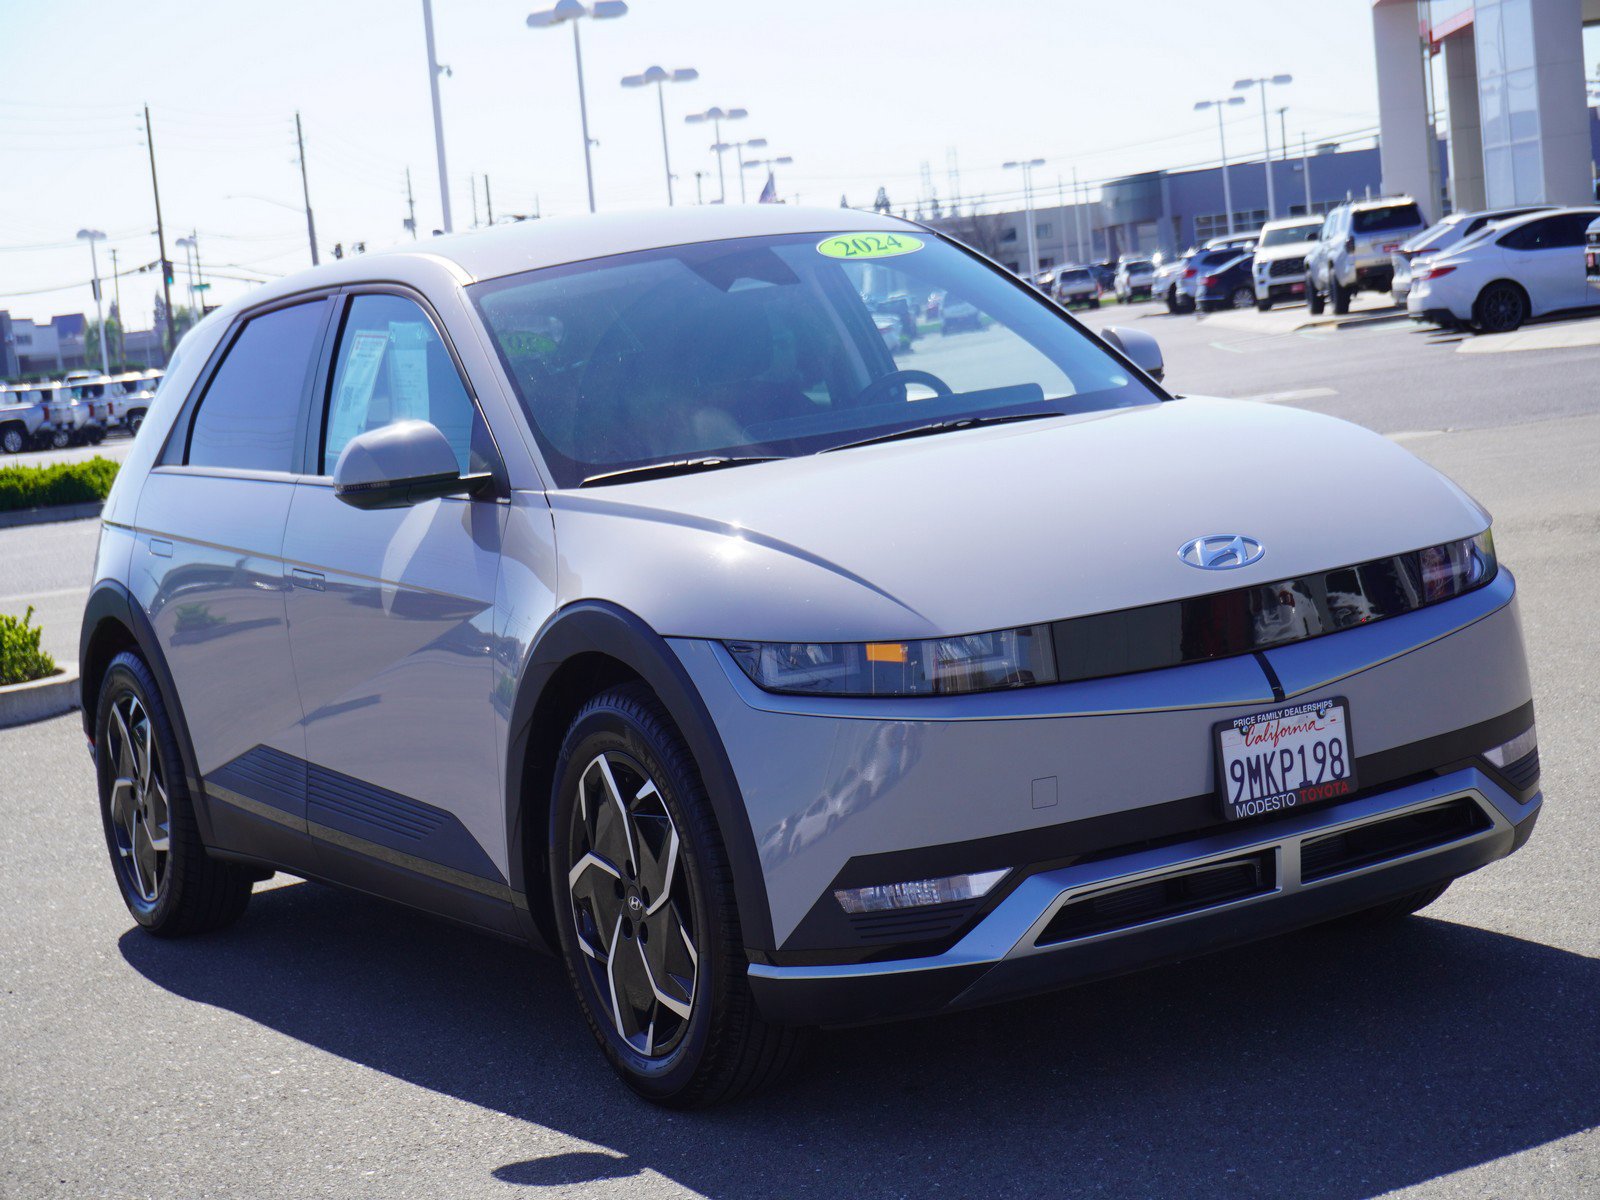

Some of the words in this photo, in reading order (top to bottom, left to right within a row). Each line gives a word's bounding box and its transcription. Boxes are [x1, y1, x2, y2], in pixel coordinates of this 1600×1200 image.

[834, 235, 903, 257] 2024
[1233, 717, 1255, 728] PRICE
[1257, 710, 1284, 723] FAMILY
[1284, 699, 1333, 716] DEALERSHIPS
[1245, 719, 1326, 748] California
[1230, 737, 1345, 804] 9MKP198
[1235, 792, 1296, 818] MODESTO
[1300, 781, 1349, 803] TOYOTA
